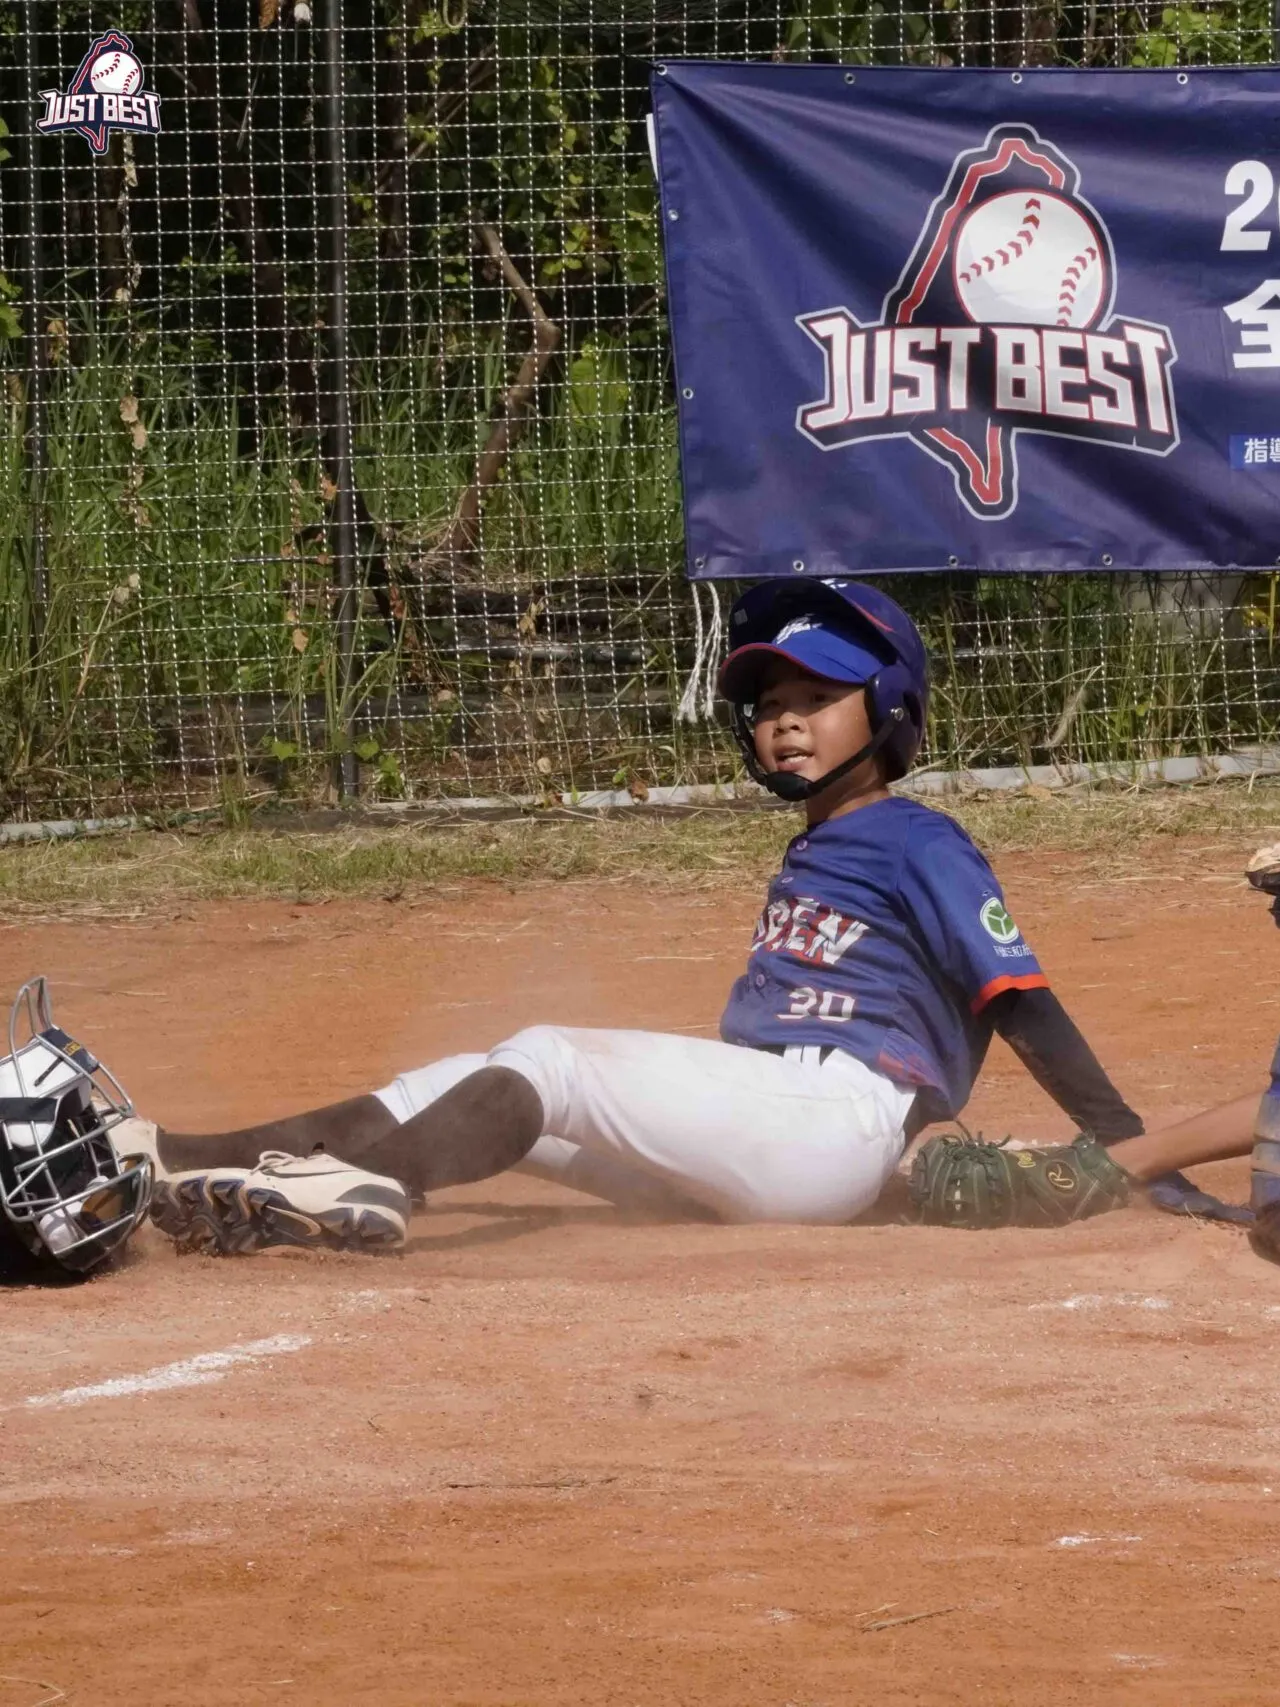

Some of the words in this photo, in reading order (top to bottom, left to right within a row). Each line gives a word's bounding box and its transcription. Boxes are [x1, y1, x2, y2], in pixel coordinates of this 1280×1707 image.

[806, 316, 980, 430] JUST
[988, 325, 1170, 435] BEST
[776, 986, 856, 1023] 30
